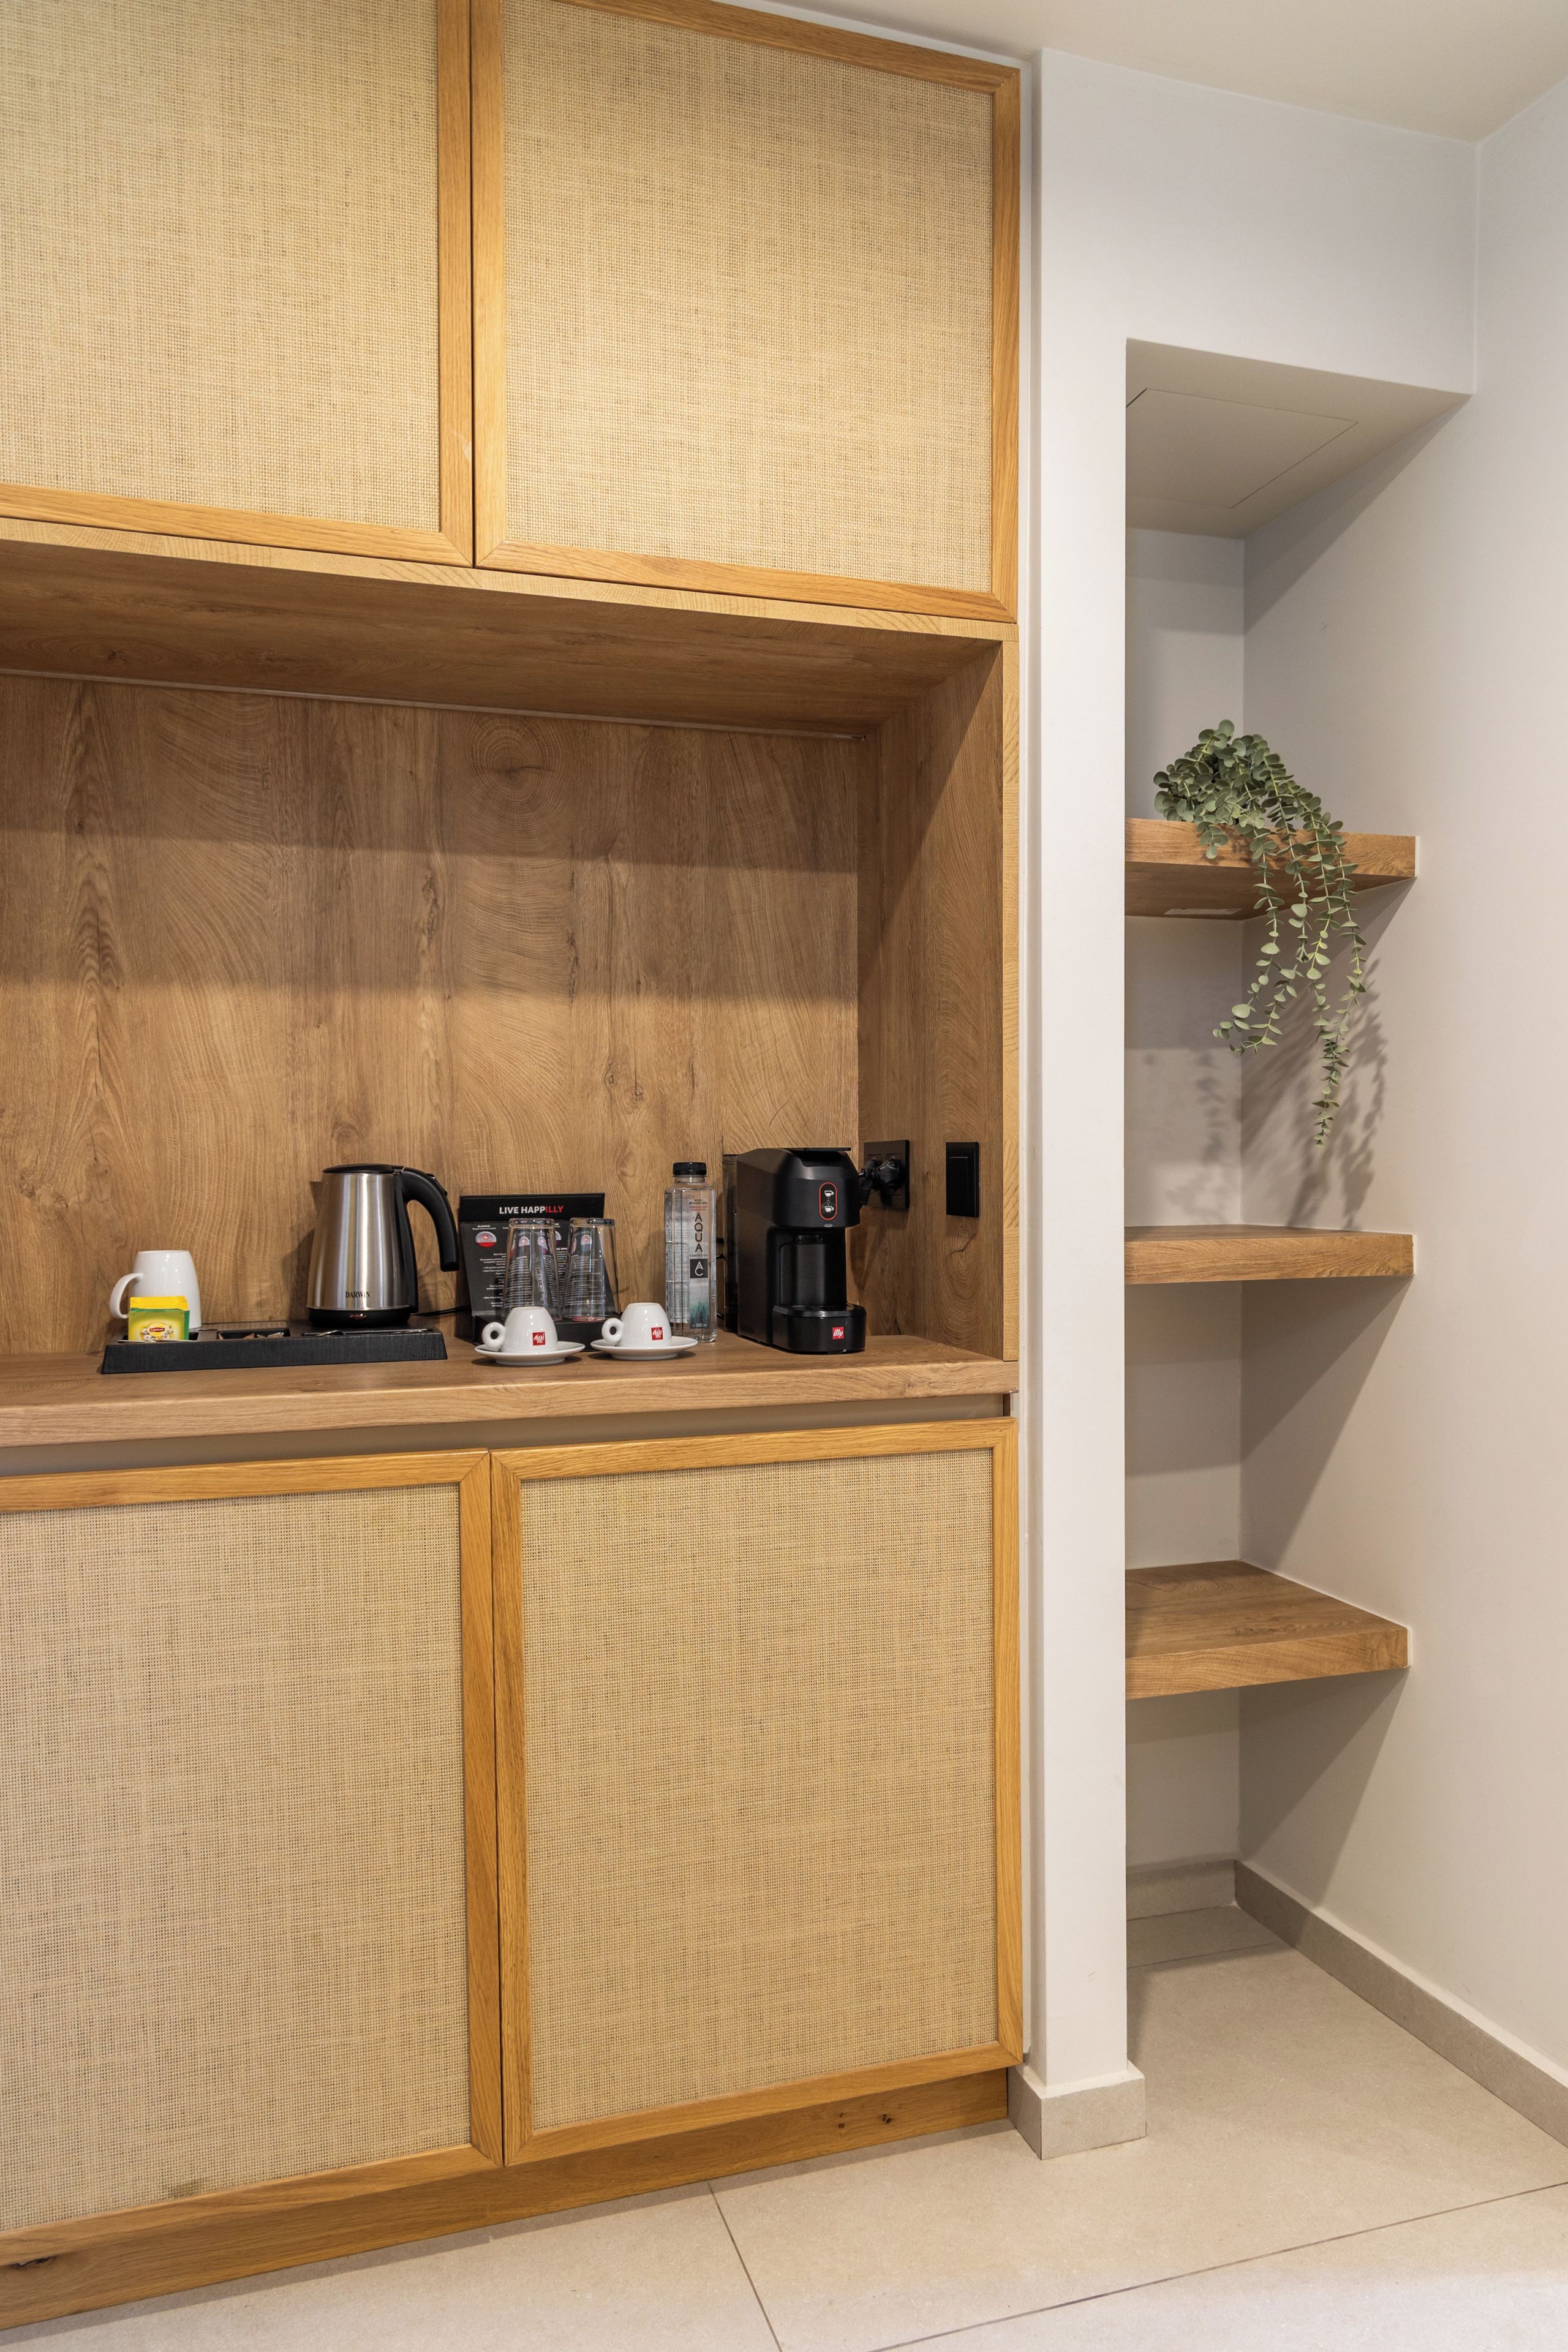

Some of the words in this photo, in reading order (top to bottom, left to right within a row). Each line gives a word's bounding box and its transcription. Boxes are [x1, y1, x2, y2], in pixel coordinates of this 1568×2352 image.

[521, 1205, 564, 1214] HAPPILLY
[694, 1212, 703, 1252] AQUA
[533, 1332, 545, 1344] illy
[652, 1329, 662, 1338] illy
[833, 1329, 843, 1339] illy
